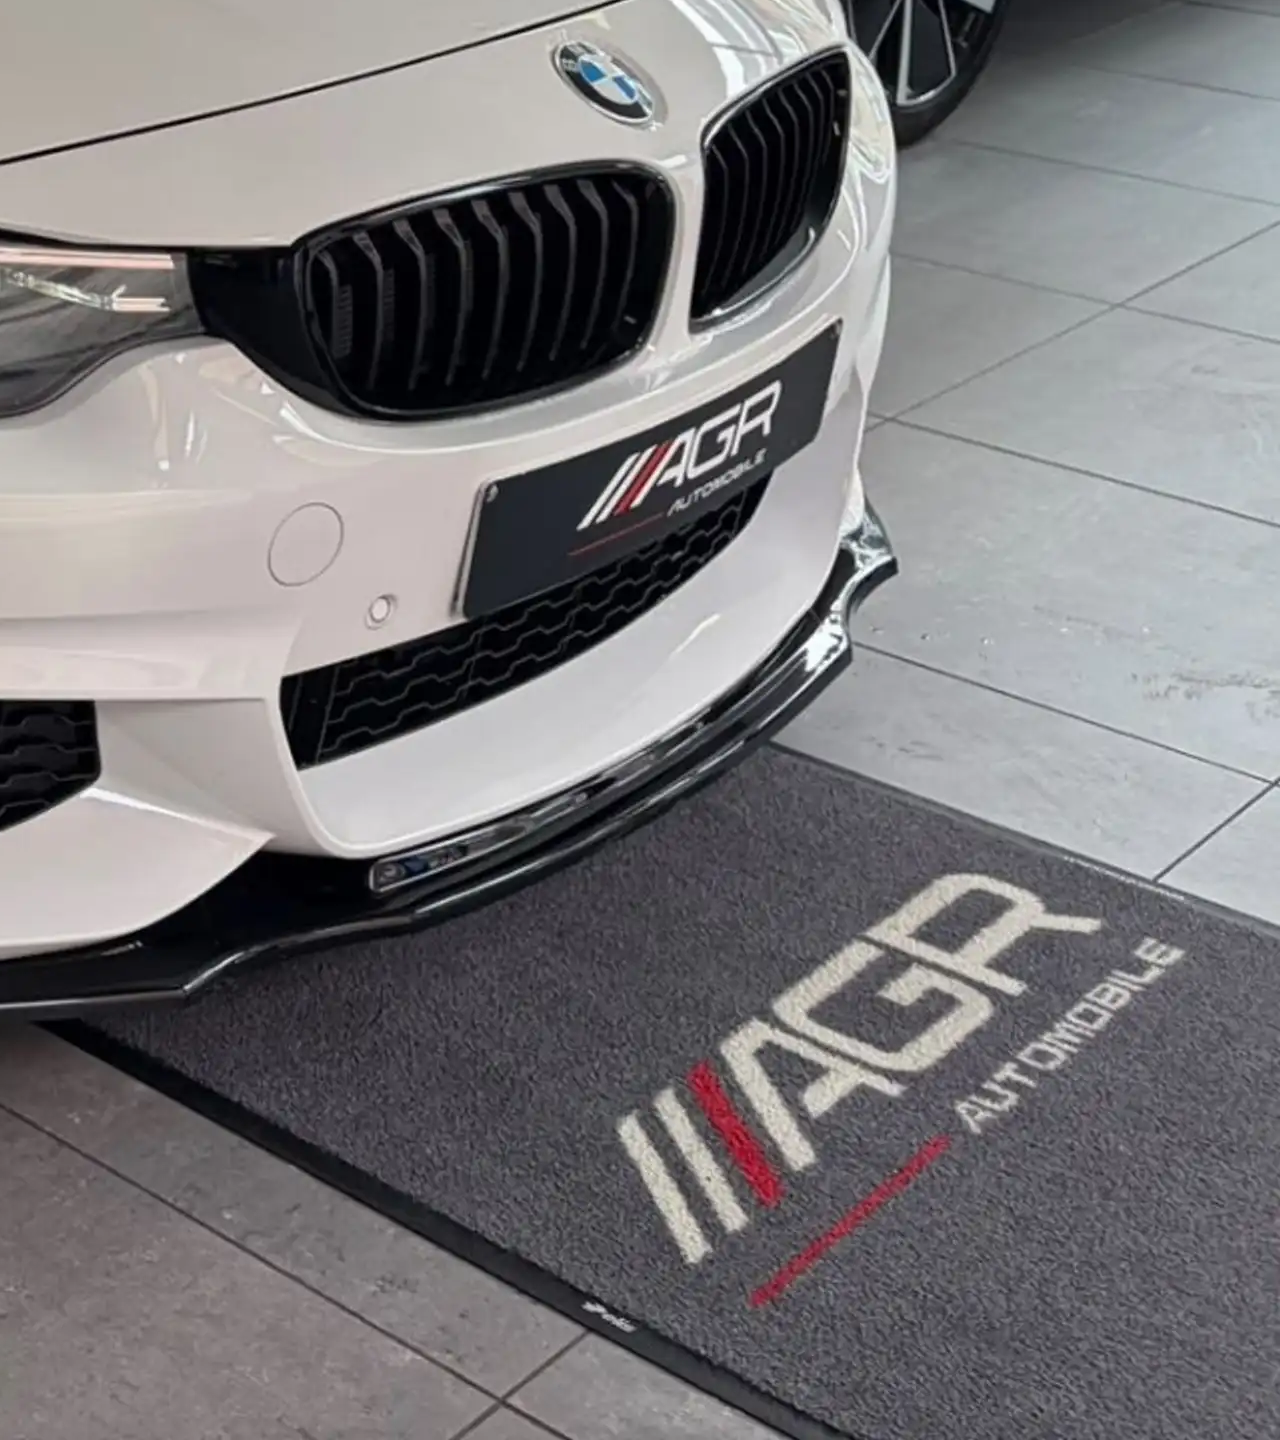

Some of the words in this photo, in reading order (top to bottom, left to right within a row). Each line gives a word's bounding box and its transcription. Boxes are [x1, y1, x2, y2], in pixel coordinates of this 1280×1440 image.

[630, 379, 783, 510] AGR
[666, 448, 766, 518] AUTOMOBILE
[719, 871, 1103, 1174] AGR
[953, 935, 1187, 1136] AUTOMOBILE
